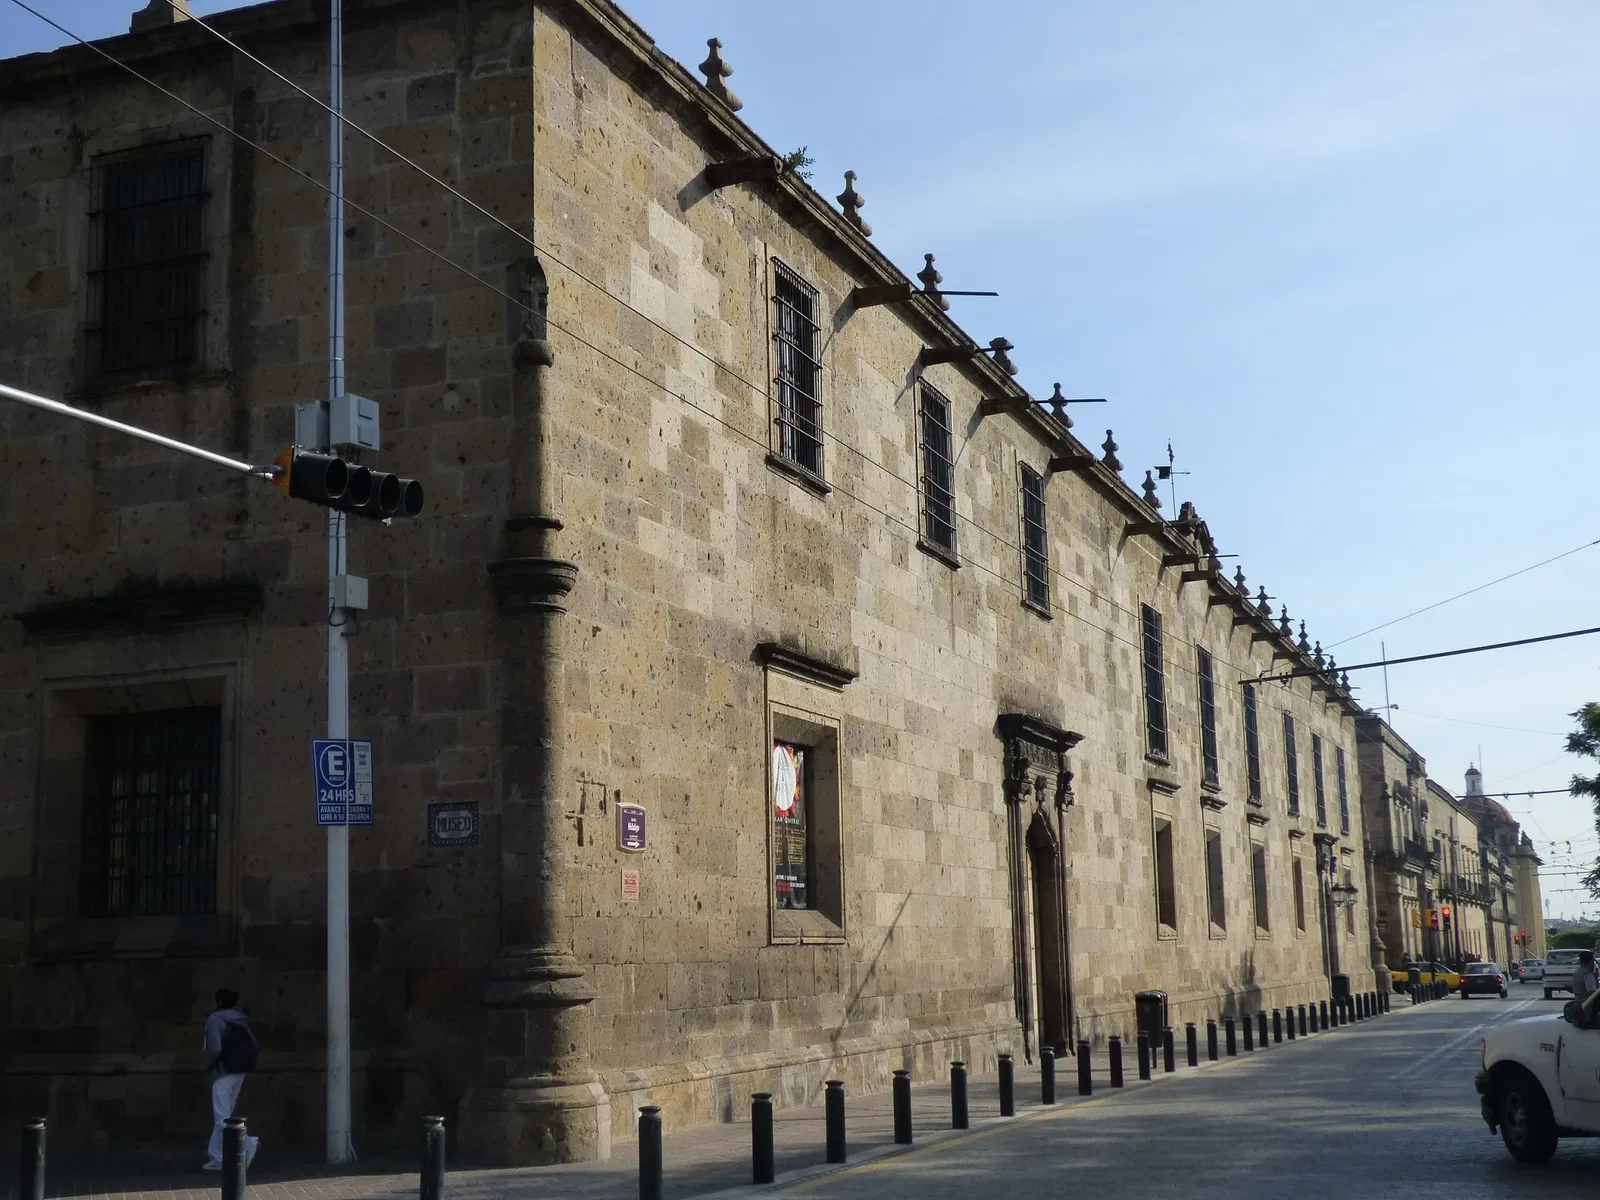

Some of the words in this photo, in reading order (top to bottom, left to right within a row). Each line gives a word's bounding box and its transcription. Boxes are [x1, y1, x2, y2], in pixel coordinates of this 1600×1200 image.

[328, 751, 344, 775] E
[320, 789, 334, 802] 24
[320, 813, 333, 821] GIRE
[334, 813, 338, 821] A
[338, 813, 345, 821] SU
[437, 816, 471, 832] MUSEO
